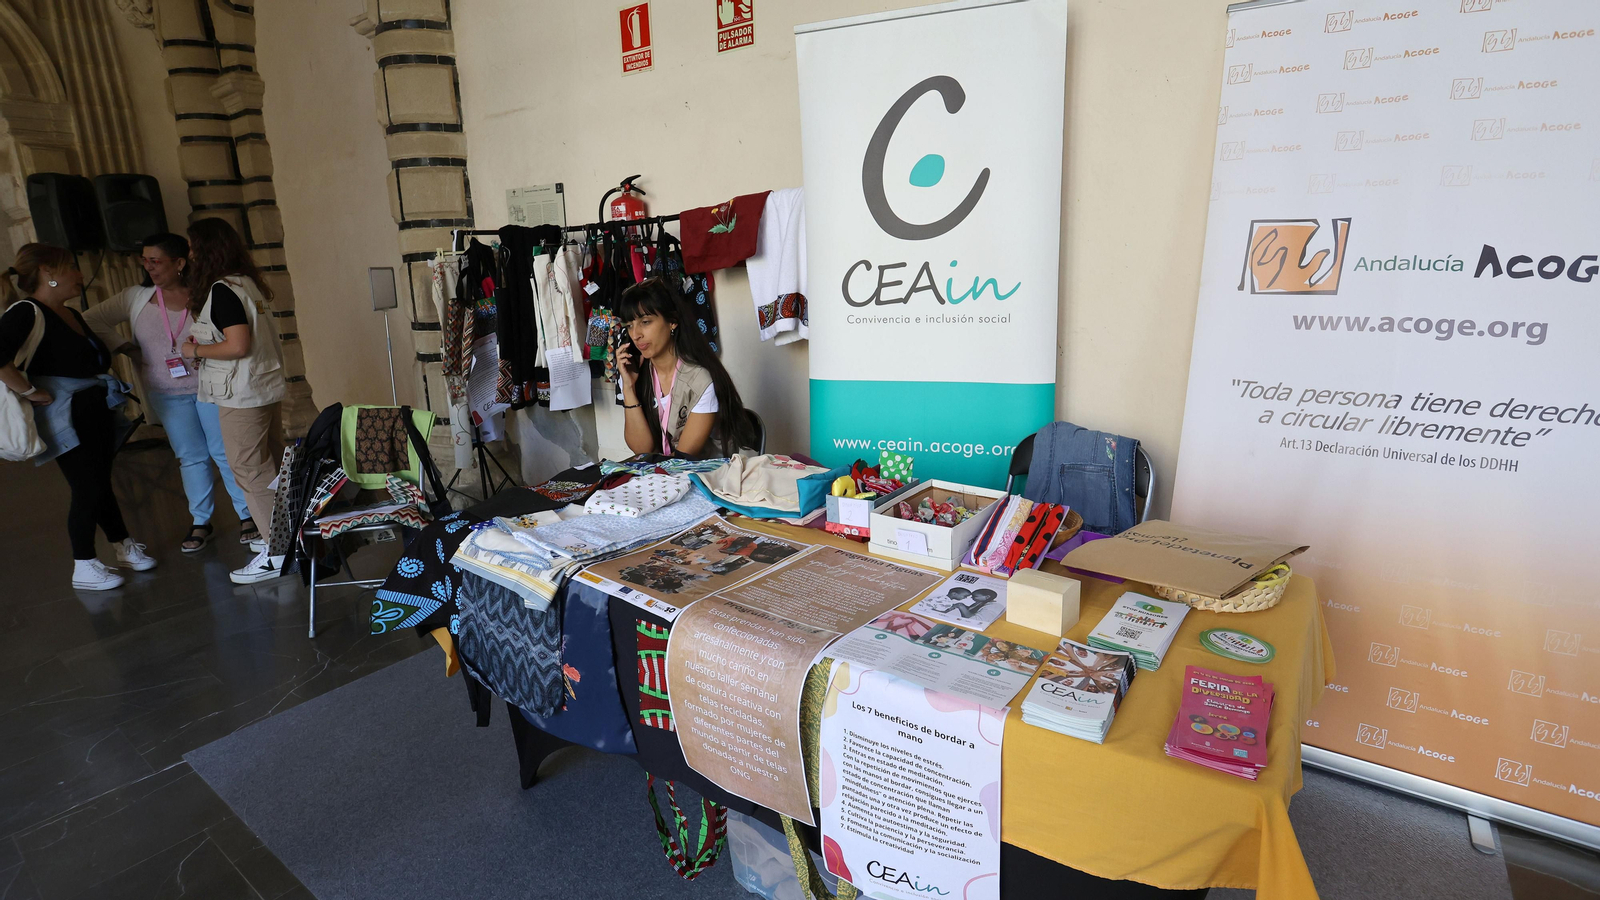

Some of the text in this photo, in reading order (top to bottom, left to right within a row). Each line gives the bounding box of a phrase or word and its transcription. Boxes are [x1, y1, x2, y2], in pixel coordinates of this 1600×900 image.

[719, 26, 752, 41] PULSADOR
[719, 36, 753, 51] DE ALARMA
[623, 53, 645, 64] EXTINTOR
[626, 59, 649, 70] INCENDIOS
[1353, 254, 1465, 272] Andalucía
[841, 259, 1022, 308] CEAin
[846, 313, 1011, 324] Convivencia e inclusión social
[1292, 314, 1549, 346] www.acoge.org
[1232, 379, 1294, 403] "Toda
[1296, 385, 1403, 411] persona
[1409, 391, 1482, 417] tiene
[1258, 408, 1274, 424] a
[1280, 408, 1374, 434] circular
[1315, 440, 1380, 459] Declaración
[1382, 446, 1438, 465] Universal
[1440, 453, 1456, 467] de
[1458, 455, 1477, 470] los
[1479, 456, 1519, 473] DDHH
[714, 521, 759, 539] Programa
[834, 548, 886, 567] Programa
[886, 561, 925, 578] Faguas
[708, 608, 806, 646] Estas prendas han sido
[724, 600, 776, 622] Programa
[694, 630, 784, 669] artesanalmente y con
[711, 622, 782, 651] confeccionadas
[685, 660, 778, 703] nuestro taller semanal
[699, 648, 768, 682] mucho cariño en
[685, 674, 781, 720] de costura creativa con
[1040, 682, 1106, 705] CEAin
[1190, 677, 1231, 693] FERIA
[1191, 686, 1251, 704] DIVERSIDAD
[684, 699, 786, 749] formado por mujeres de
[699, 694, 765, 728] telas recicladas,
[852, 701, 866, 712] Los
[874, 709, 919, 730] beneficios
[920, 726, 932, 735] de
[934, 729, 967, 746] bordar
[691, 726, 720, 744] mundo
[728, 743, 751, 758] partir
[753, 754, 764, 764] de
[765, 757, 788, 774] telas
[693, 716, 779, 758] diferentes partes del
[849, 730, 879, 747] Disminuye
[890, 747, 913, 758] niveles
[922, 758, 944, 770] estrés.
[898, 730, 923, 744] mano
[702, 742, 737, 763] donadas
[746, 762, 779, 781] nuestra
[728, 765, 753, 781] ONG.
[849, 738, 874, 753] Favorece
[882, 752, 914, 766] capacidad
[923, 767, 972, 788] concentración.
[849, 746, 867, 758] Entras
[876, 759, 898, 769] estado
[907, 769, 945, 787] meditación.
[846, 825, 872, 840] Estimula
[879, 839, 914, 855] creatividad
[847, 802, 874, 817] Aumenta
[882, 817, 918, 832] autoestima
[932, 834, 967, 848] seguridad.
[847, 810, 867, 822] Cultiva
[875, 821, 904, 836] paciencia
[917, 837, 966, 855] perseverancia.
[866, 860, 950, 896] CEAin
